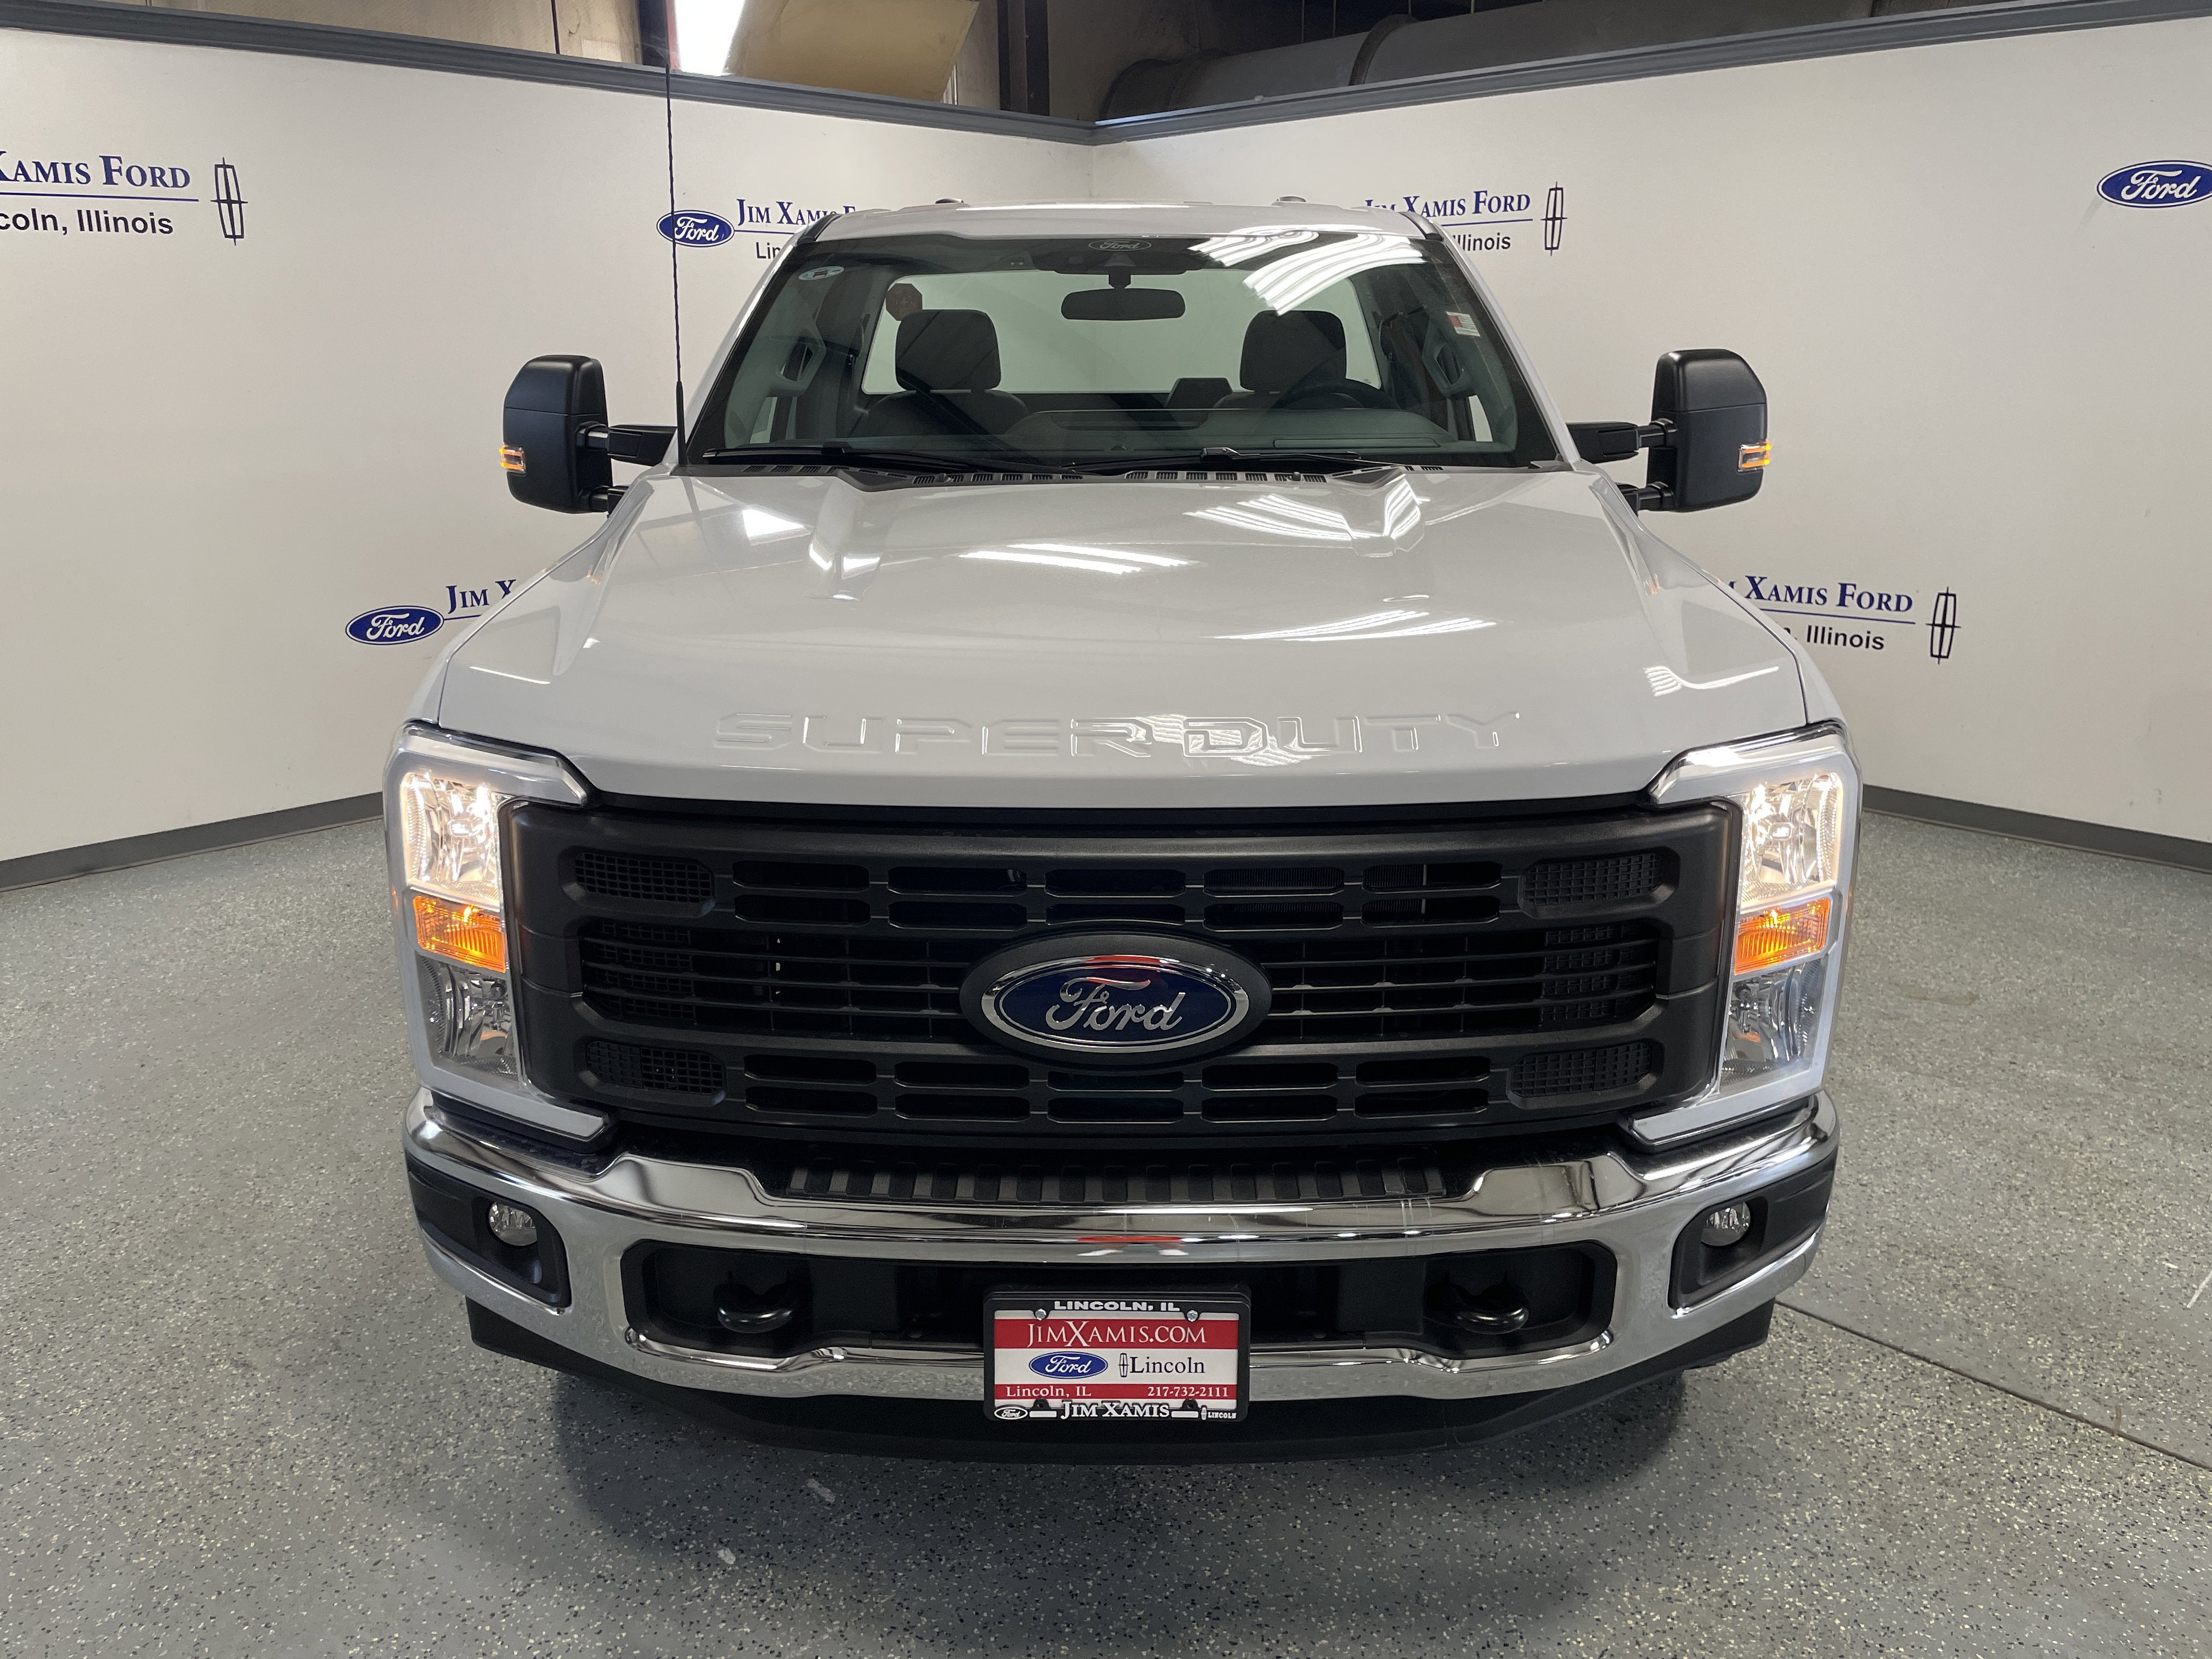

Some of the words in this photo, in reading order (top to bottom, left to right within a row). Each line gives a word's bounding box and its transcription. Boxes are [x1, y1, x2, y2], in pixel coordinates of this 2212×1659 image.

[99, 155, 190, 188] FORD
[2121, 170, 2202, 200] Ford
[736, 199, 771, 225] JIM
[1472, 190, 1530, 215] FORD
[0, 208, 67, 235] coln,
[77, 209, 173, 235] Illinois
[674, 216, 719, 241] Ford
[1099, 240, 1140, 249] Ford
[1453, 233, 1511, 251] llinois
[445, 585, 489, 614] JIM
[1745, 575, 1827, 606] XAMIS
[1836, 582, 1913, 612] FORD
[366, 613, 425, 640] Ford
[1807, 625, 1885, 650] Illinois
[715, 713, 1152, 757] SUPER
[1182, 712, 1520, 757] DUTY
[1045, 977, 1186, 1030] Ford
[1054, 1301, 1153, 1311] LINCOLN,
[1160, 1302, 1180, 1311] IL
[1027, 1321, 1207, 1347] JIMXAMIS.COM
[1045, 1355, 1092, 1373] Ford
[1130, 1357, 1205, 1373] Lincoln
[1006, 1386, 1069, 1397] Lincoln,
[1076, 1386, 1092, 1396] IL
[1147, 1386, 1228, 1397] 217-732-2111
[1001, 1409, 1020, 1418] Ford
[1060, 1401, 1098, 1419] JIM
[1102, 1402, 1170, 1418] XAMIS
